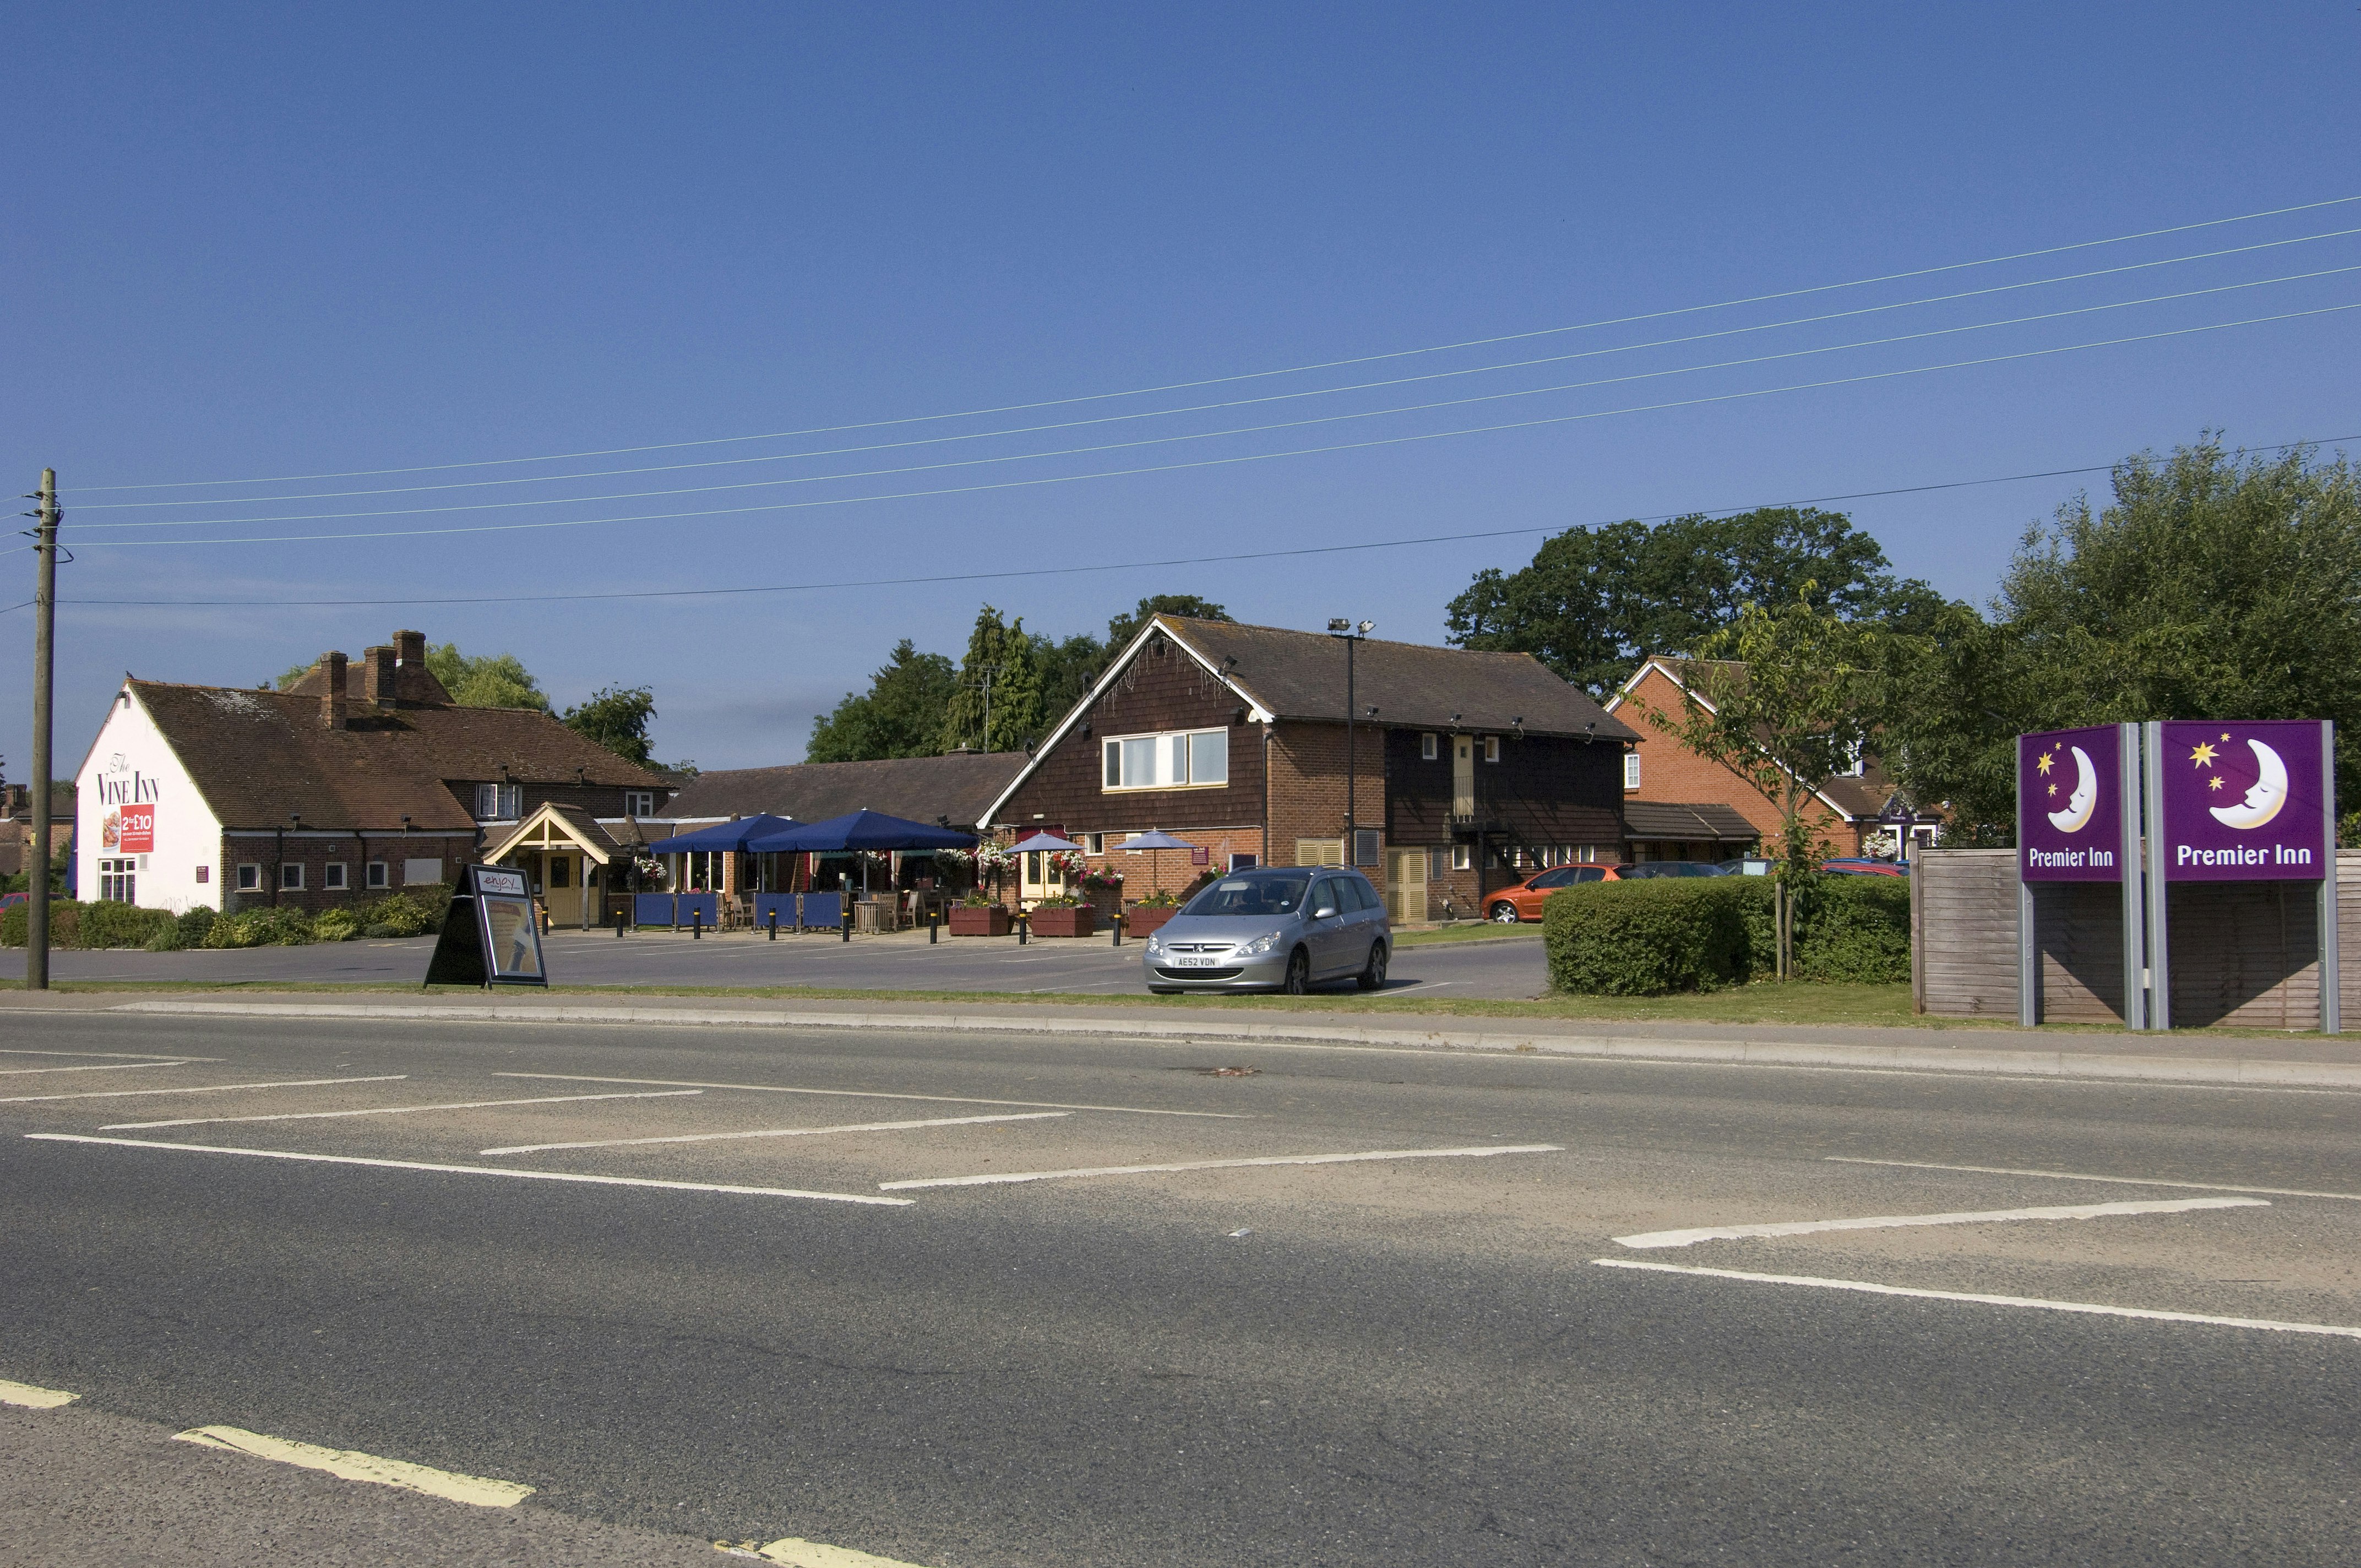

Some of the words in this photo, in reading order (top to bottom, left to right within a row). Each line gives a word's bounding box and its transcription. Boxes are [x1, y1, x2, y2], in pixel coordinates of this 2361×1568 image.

[110, 753, 130, 773] The
[97, 773, 129, 805] VINE
[134, 771, 160, 803] INN
[123, 816, 129, 830] 2
[2029, 847, 2085, 867] Premier
[2089, 847, 2113, 867] Inn
[2177, 844, 2270, 865] Premier
[2275, 844, 2311, 864] Inn
[483, 874, 515, 891] enjoy
